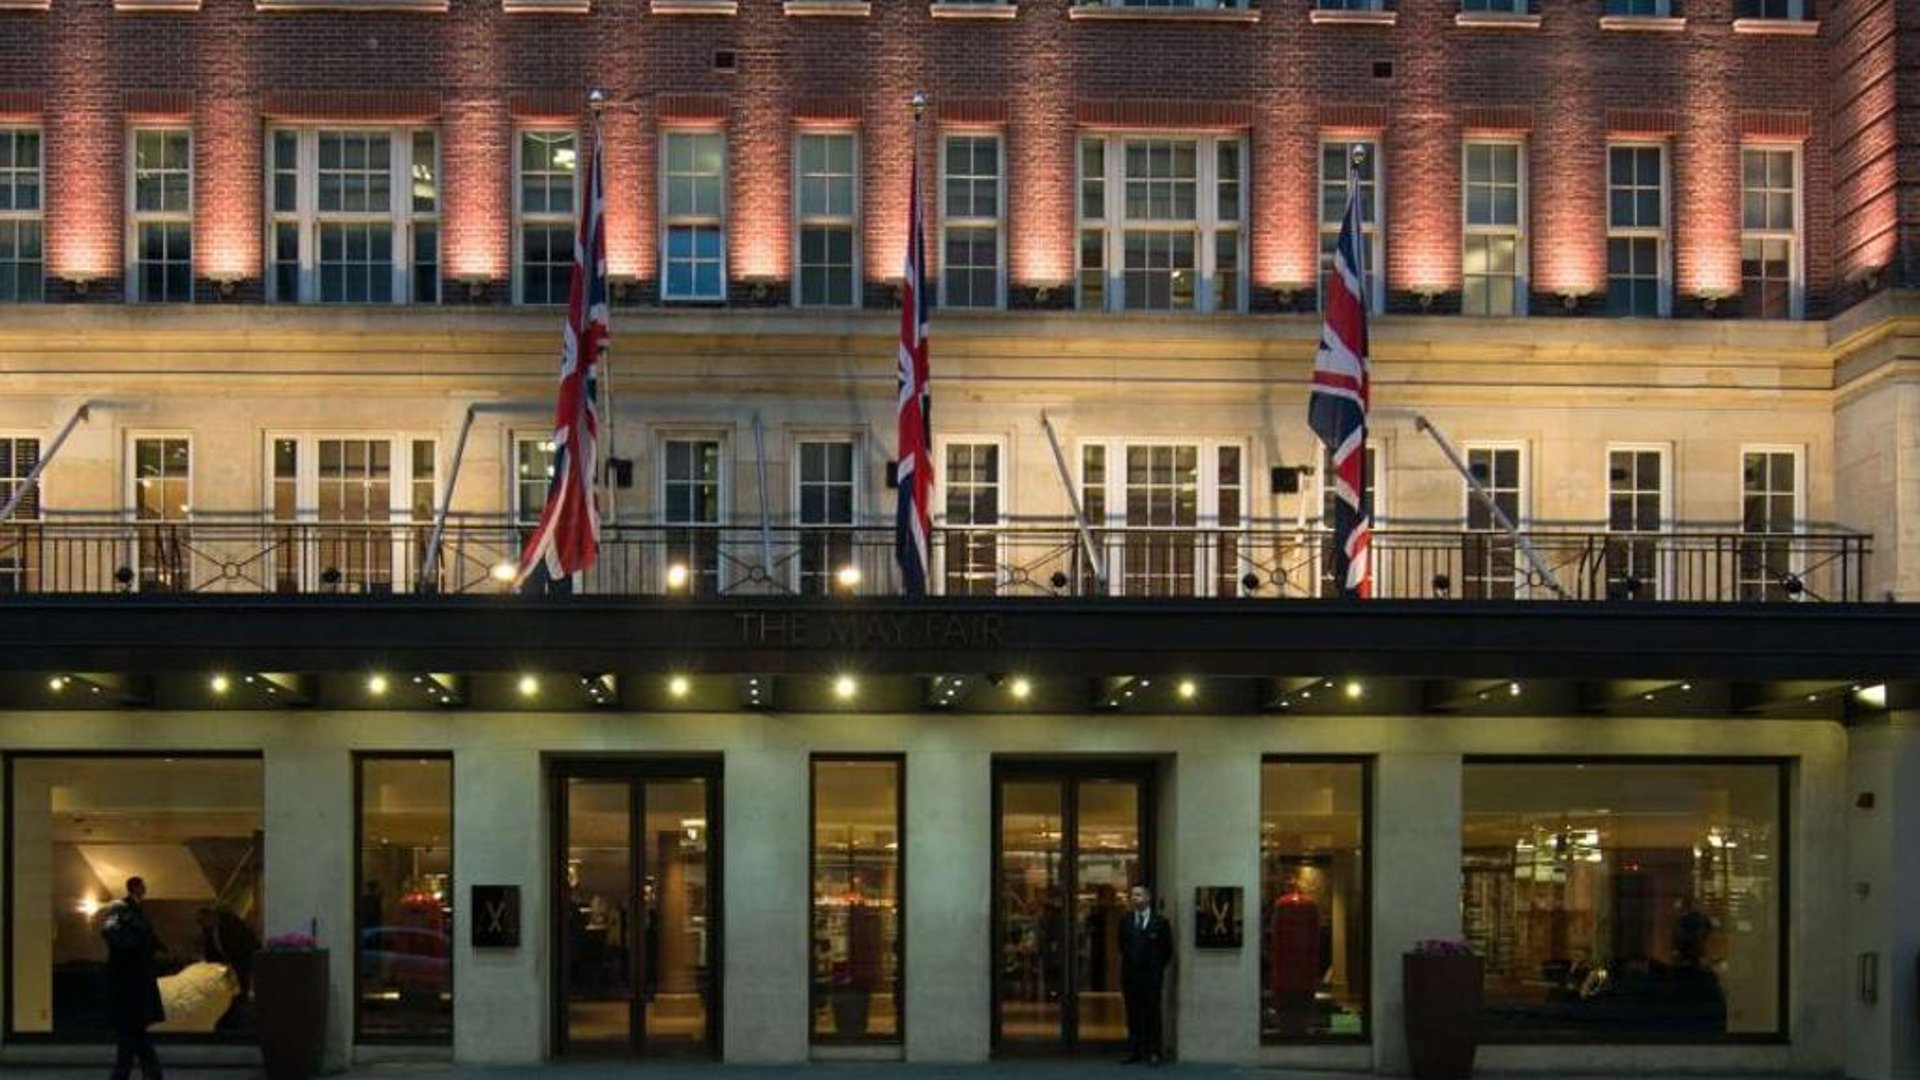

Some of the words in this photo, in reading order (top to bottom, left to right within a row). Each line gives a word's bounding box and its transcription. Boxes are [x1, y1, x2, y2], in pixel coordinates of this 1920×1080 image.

[735, 612, 807, 646] THE
[827, 613, 907, 647] MAY
[926, 614, 1006, 648] FAIR
